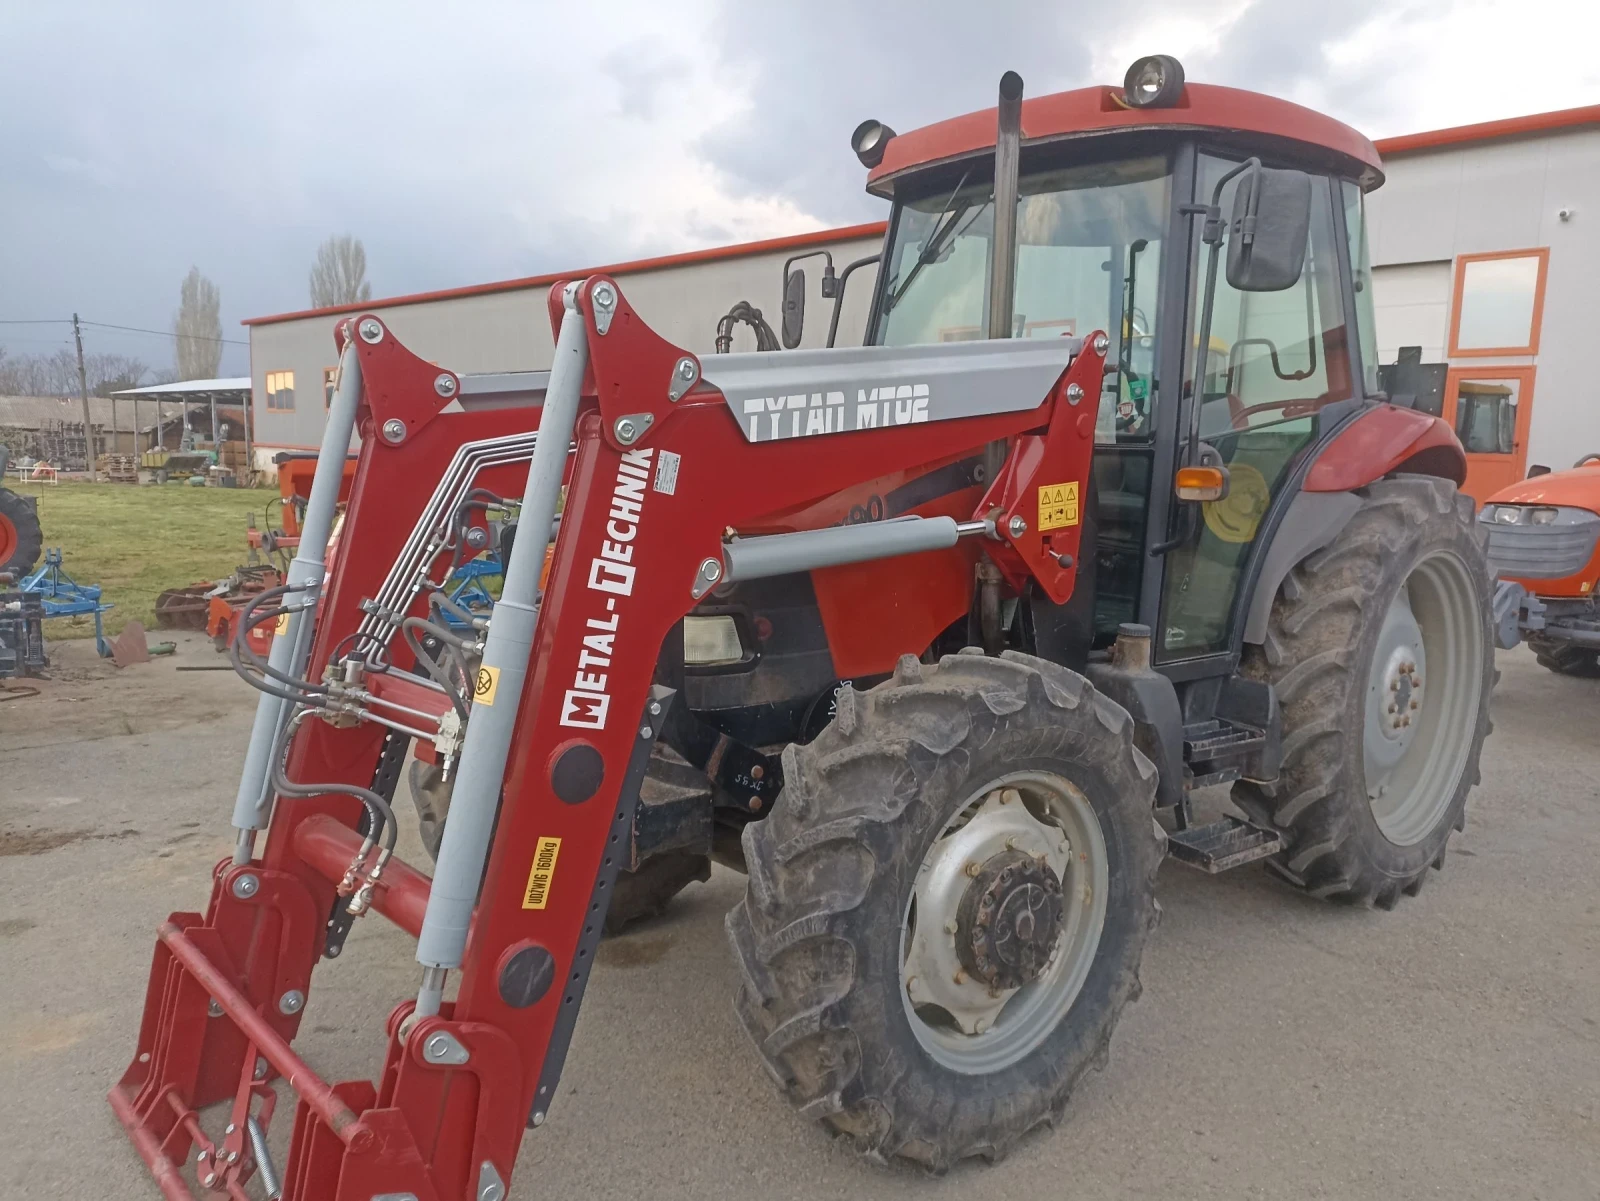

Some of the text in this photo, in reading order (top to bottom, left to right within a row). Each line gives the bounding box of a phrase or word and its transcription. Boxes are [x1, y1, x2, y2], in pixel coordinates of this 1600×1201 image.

[743, 391, 845, 442] TYTAN
[559, 447, 654, 730] METAL-TECHNIK
[528, 842, 558, 904] UDŹWIG 1600kg
